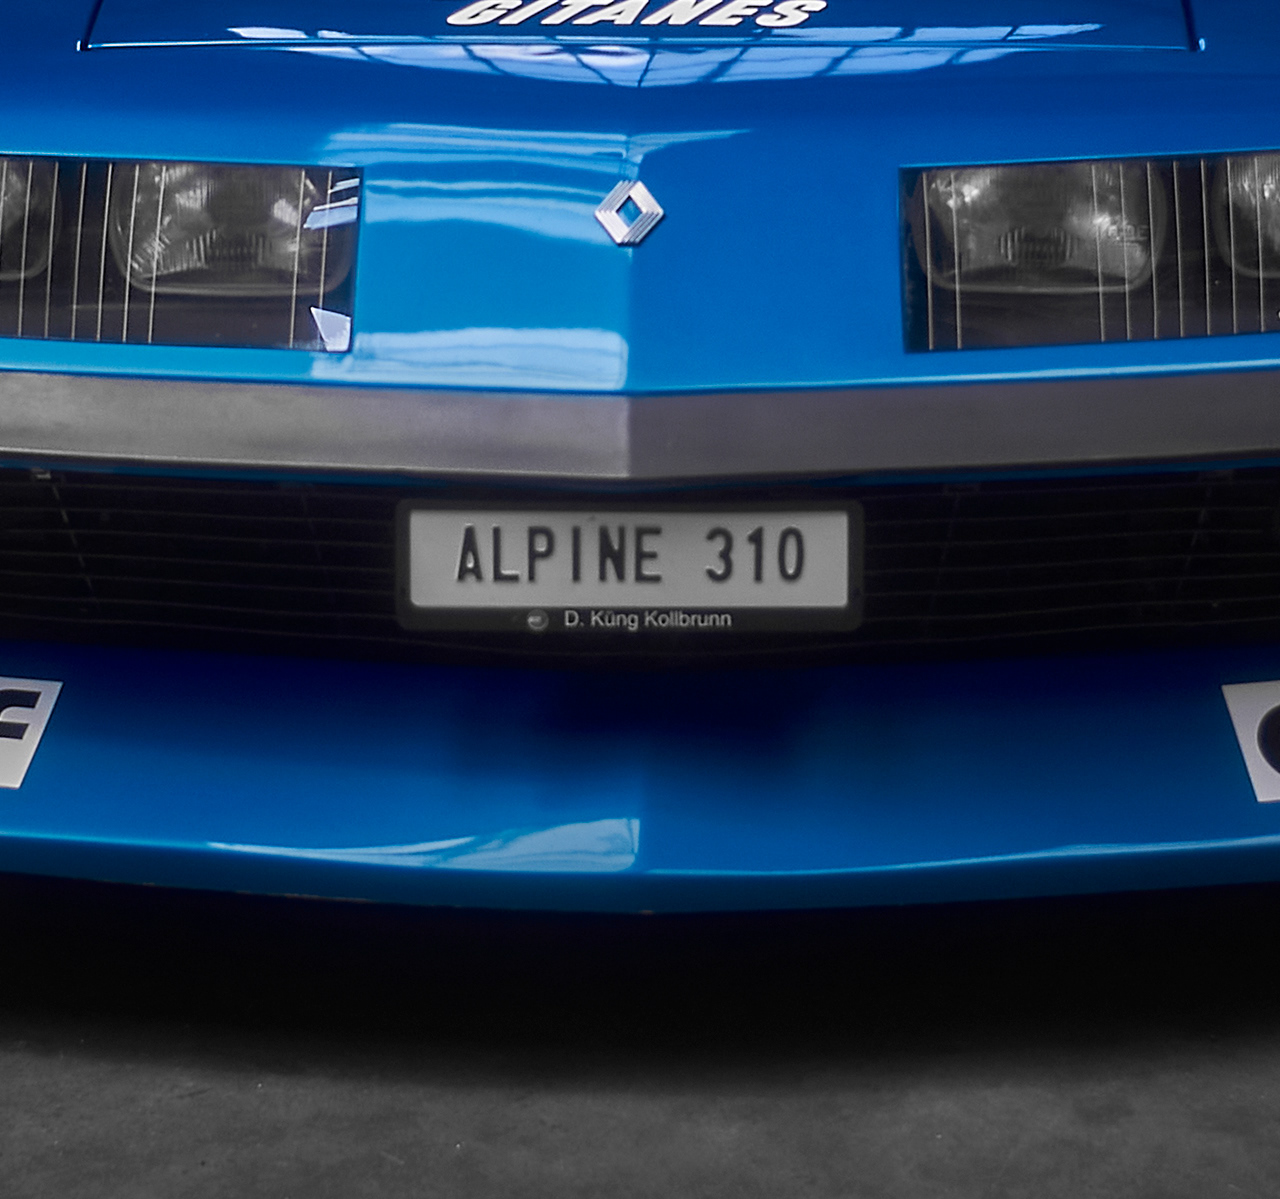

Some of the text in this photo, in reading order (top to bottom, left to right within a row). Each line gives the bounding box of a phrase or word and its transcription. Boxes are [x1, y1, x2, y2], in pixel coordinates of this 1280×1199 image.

[457, 523, 807, 583] ALPINE 310
[564, 609, 733, 632] D. Küng Kollbrunn
